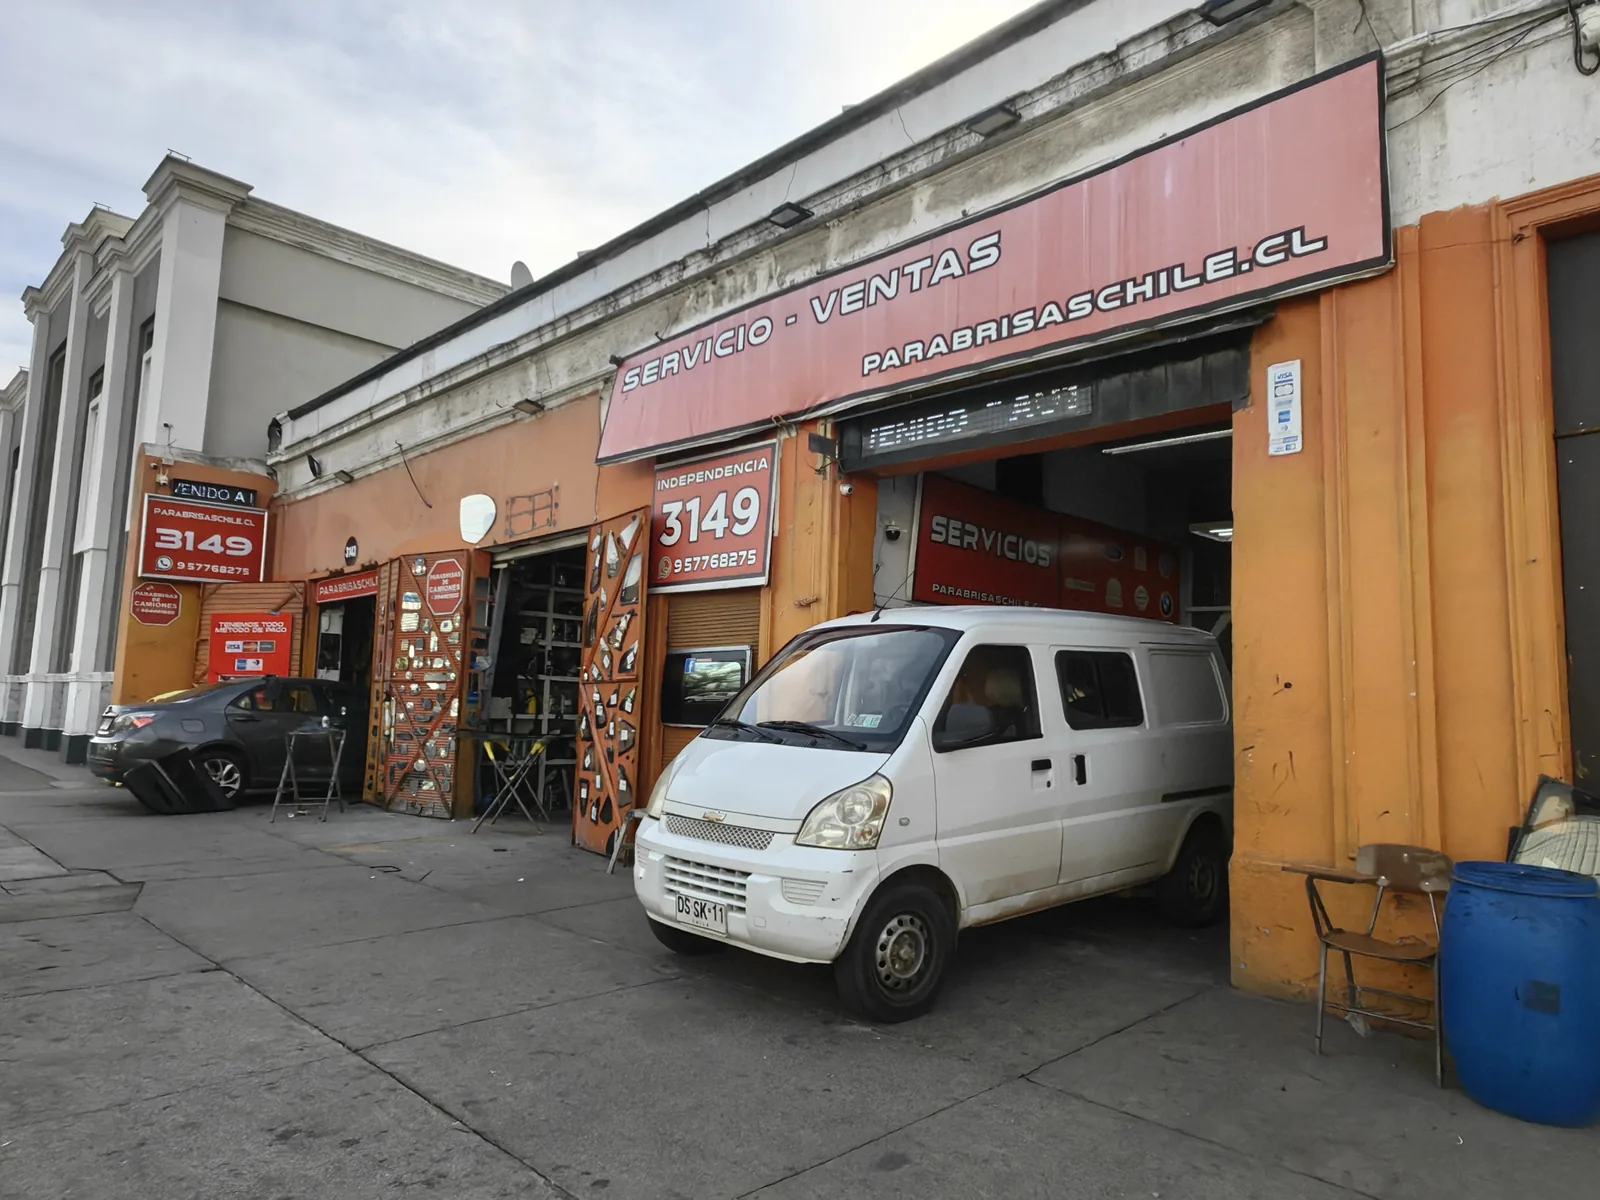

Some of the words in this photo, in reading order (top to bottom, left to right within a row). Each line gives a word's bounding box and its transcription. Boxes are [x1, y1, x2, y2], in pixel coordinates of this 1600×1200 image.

[621, 316, 773, 393] SERVICIO
[785, 314, 798, 327] -
[810, 230, 1001, 325] VENTAS
[862, 225, 1328, 377] PARABRISASCHILE.CL
[1276, 371, 1293, 381] VISA
[656, 456, 769, 491] INDEPENDENCIA
[234, 491, 246, 503] A
[153, 507, 256, 527] PARABRISASCHILE.CL
[657, 486, 761, 548] 3149
[154, 527, 254, 557] 3149
[930, 514, 1052, 568] SERVICIOS
[134, 600, 178, 609] CAMIONES
